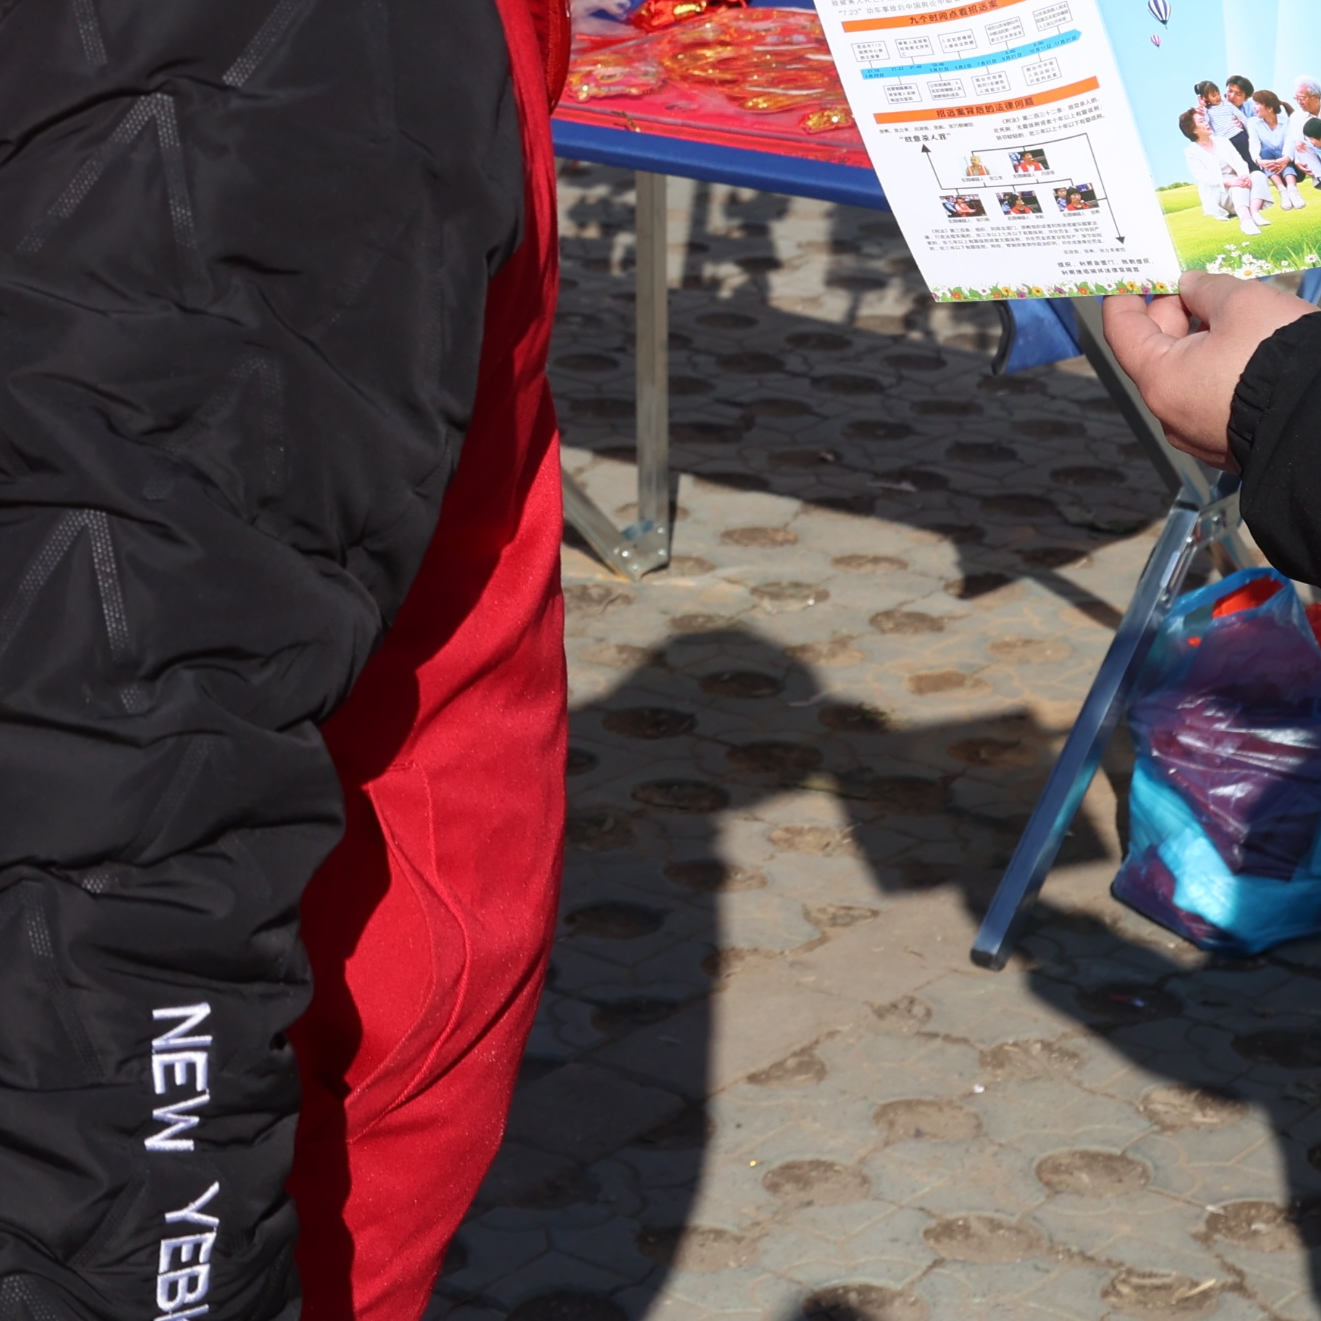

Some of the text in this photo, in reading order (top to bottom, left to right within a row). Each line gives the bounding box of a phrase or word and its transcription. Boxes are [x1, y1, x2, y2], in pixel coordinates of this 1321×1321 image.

[909, 0, 999, 25] 九个时间点看招远案
[936, 97, 1035, 118] 招远案背后的法律问题
[144, 1002, 213, 1151] NEW
[153, 1181, 220, 1321] YEB
